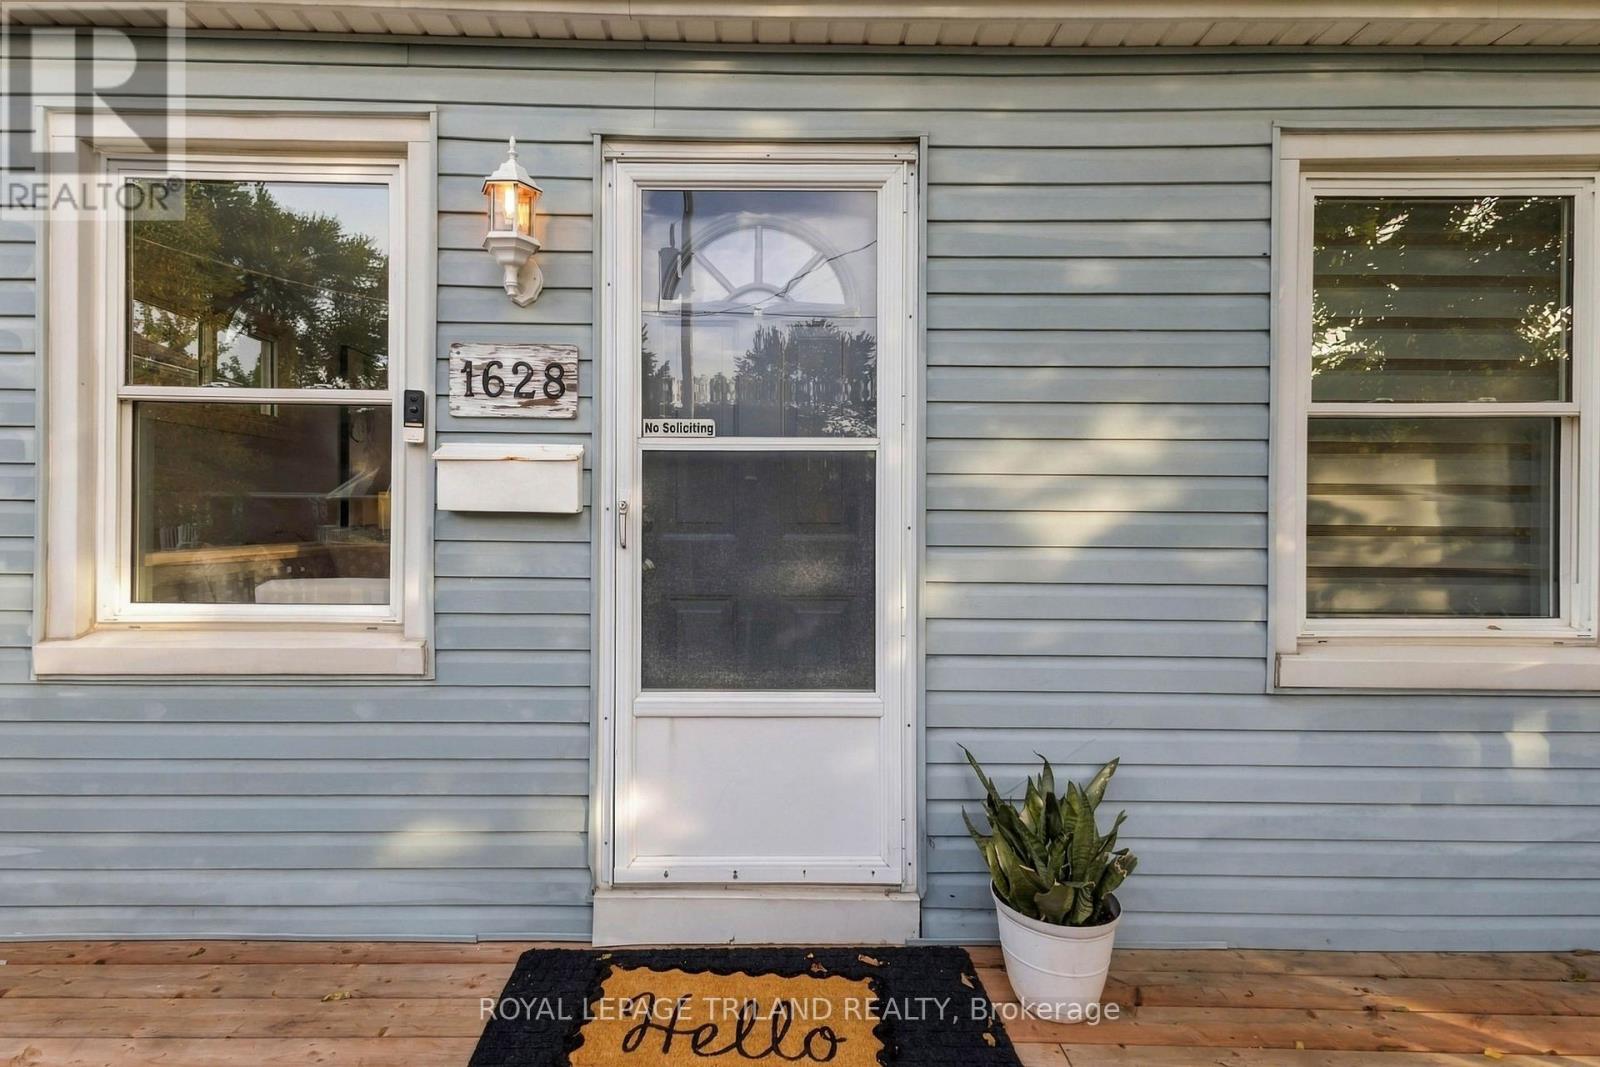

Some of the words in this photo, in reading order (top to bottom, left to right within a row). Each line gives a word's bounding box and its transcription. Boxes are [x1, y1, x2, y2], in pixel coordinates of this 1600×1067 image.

[460, 360, 566, 399] 1628
[644, 422, 660, 434] No
[662, 422, 714, 435] Soliciting
[622, 992, 847, 1062] Hello
